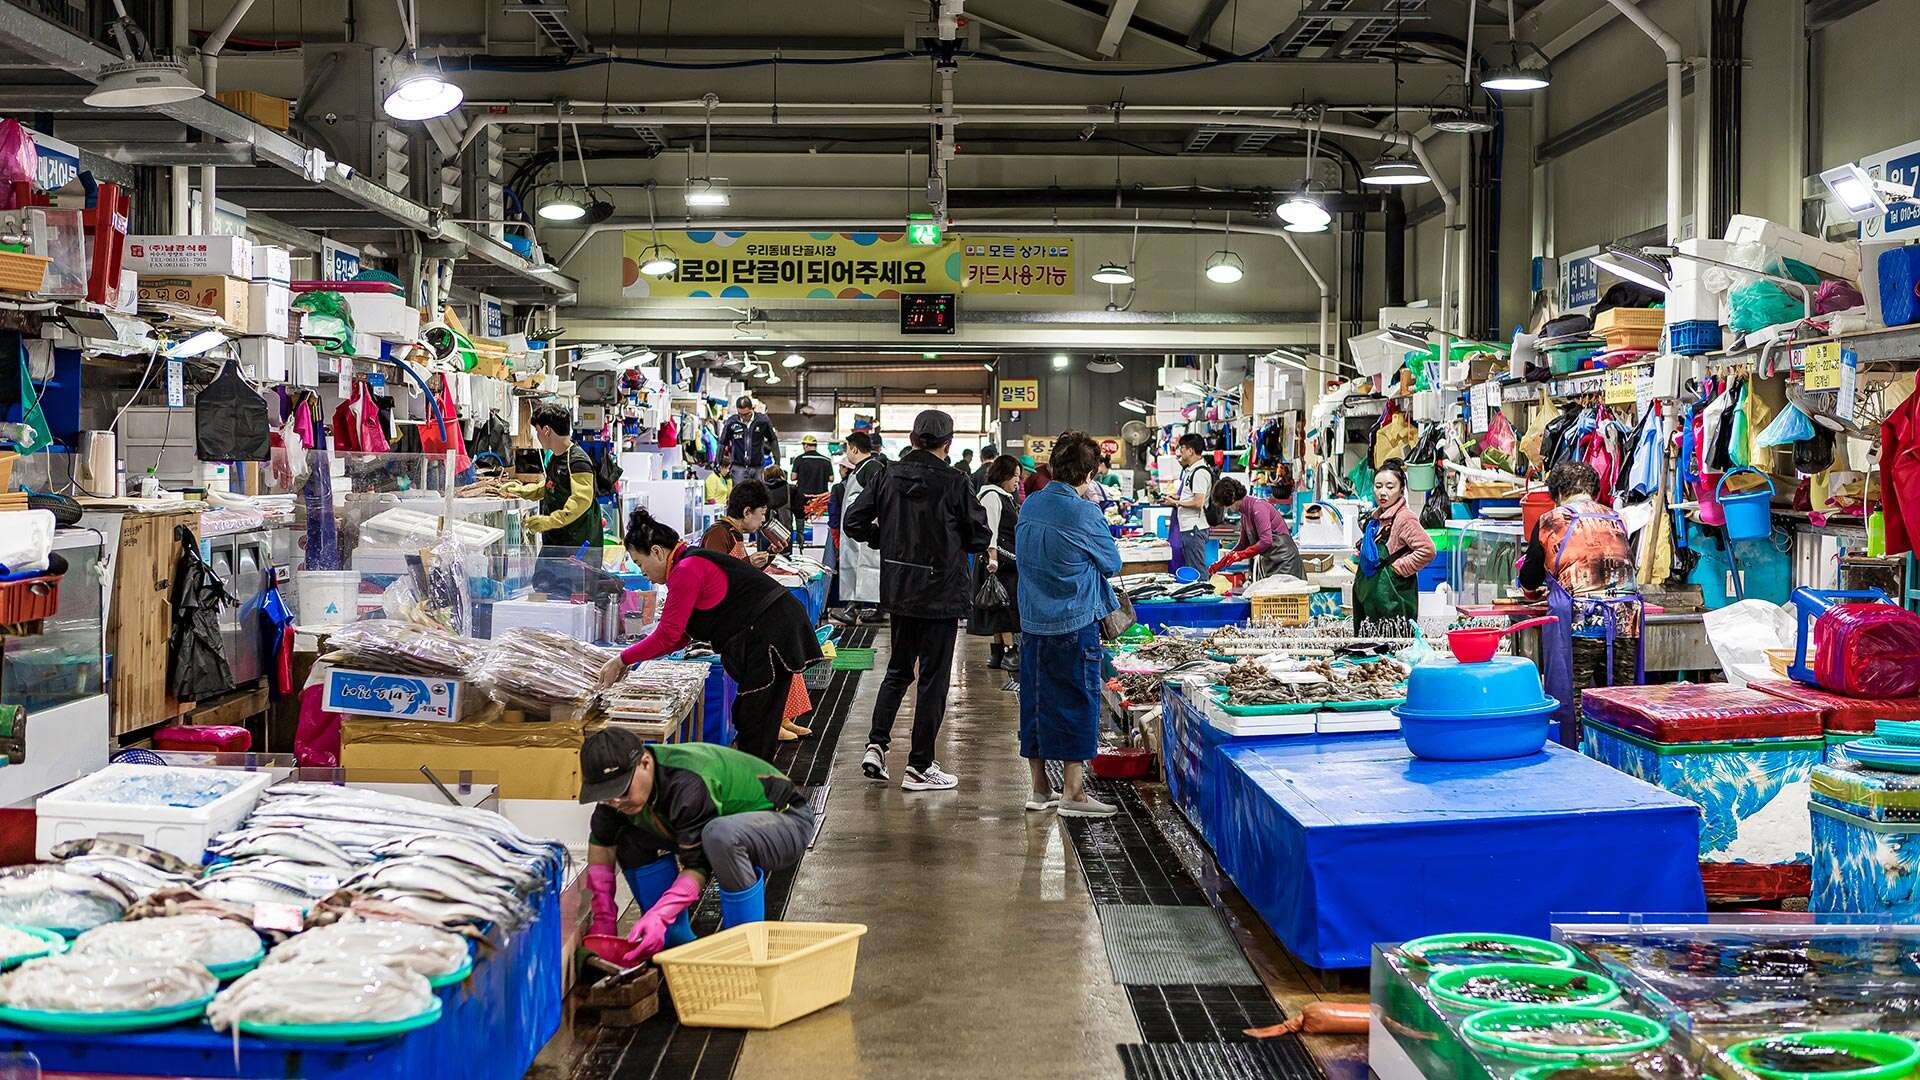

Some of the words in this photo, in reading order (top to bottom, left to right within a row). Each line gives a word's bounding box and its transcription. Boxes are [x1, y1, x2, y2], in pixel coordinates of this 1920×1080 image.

[746, 244, 790, 256] 우리동네
[792, 244, 837, 257] 단골시장
[989, 245, 1015, 257] 모든
[1020, 245, 1046, 258] 상가
[733, 259, 803, 284] 단골이
[807, 260, 927, 285] 되어주세요
